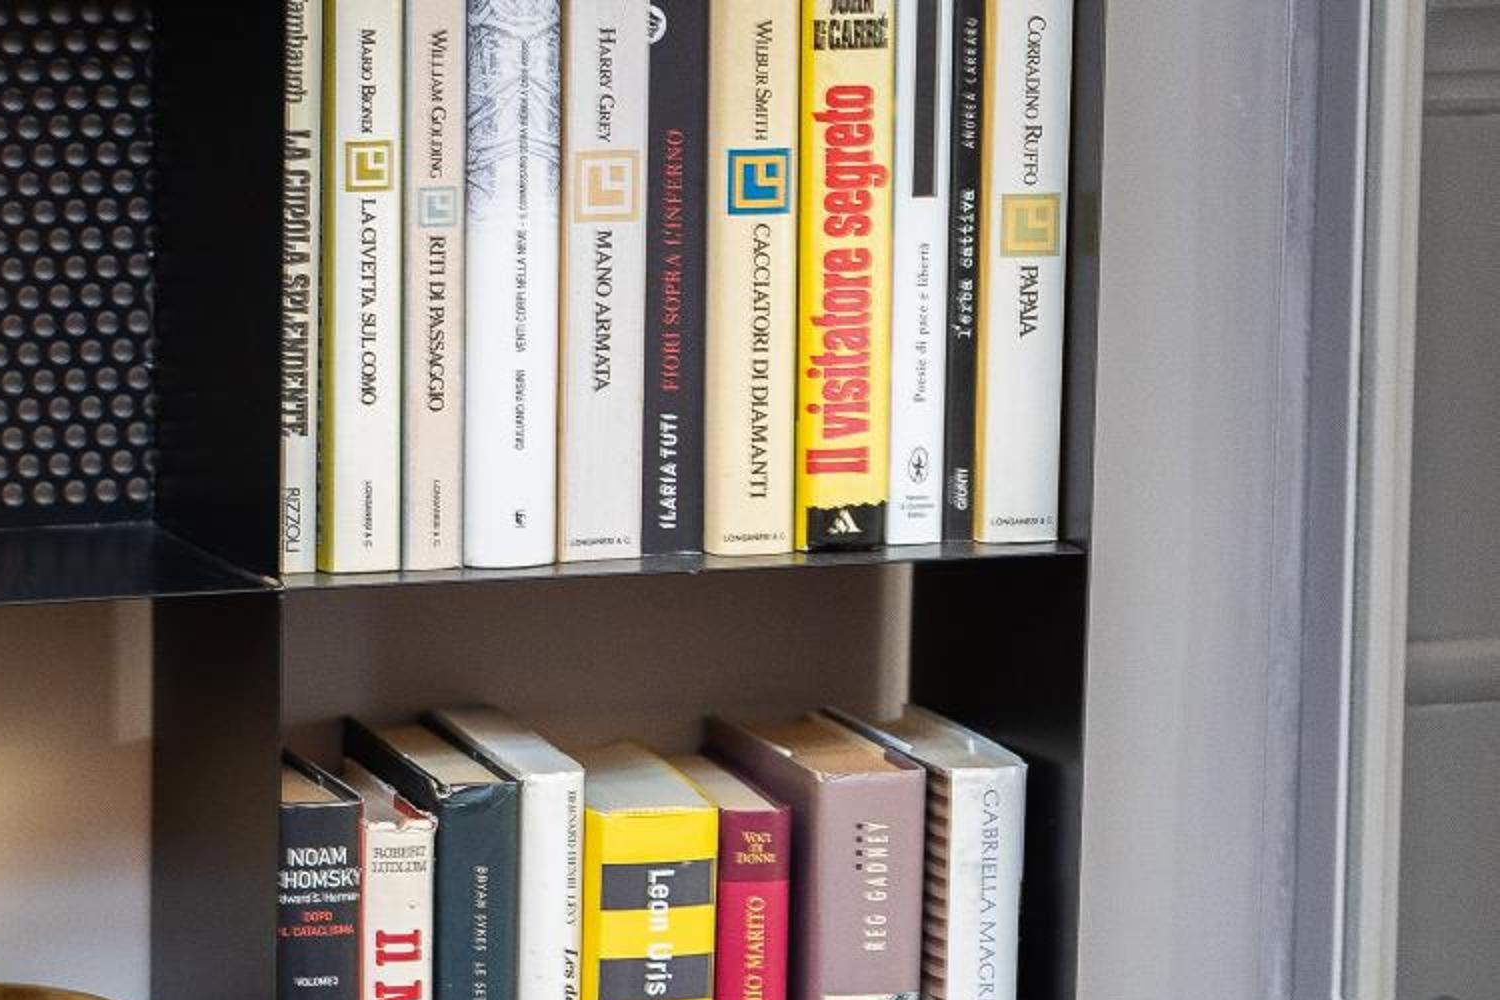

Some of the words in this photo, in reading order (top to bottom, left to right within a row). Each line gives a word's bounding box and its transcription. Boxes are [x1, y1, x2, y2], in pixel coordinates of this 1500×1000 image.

[963, 92, 977, 149] ANDREA
[663, 126, 684, 245] L'INFERNO
[811, 83, 890, 237] segreto
[283, 169, 311, 264] CUPOLA
[359, 228, 377, 307] CIVETTA
[427, 236, 445, 275] RITI
[594, 231, 612, 298] MANO
[916, 241, 930, 286] libertà
[427, 281, 445, 302] DI
[662, 253, 682, 324] SOPRA
[751, 223, 771, 352] CACCIATORI
[1018, 265, 1038, 337] PAPAIA
[359, 312, 376, 348] SUL
[593, 302, 611, 391] ARMATA
[806, 248, 872, 439] visitatore
[914, 340, 928, 353] di
[916, 304, 930, 334] pace
[281, 273, 310, 437] SPLENDENTE
[426, 306, 445, 413] PASSAGGIO
[661, 332, 680, 391] FIORI
[750, 359, 768, 379] DI
[912, 357, 927, 402] Poesie
[660, 412, 678, 457] TUTI
[747, 386, 768, 499] DIAMANTI
[805, 445, 869, 474] Il
[283, 487, 300, 553] RIZZOLI
[659, 461, 677, 528] ILARIA
[286, 847, 348, 867] NOAM
[372, 845, 426, 859] ROBERT
[866, 821, 891, 903] GADNEY
[980, 788, 1000, 912] GABRIELLA
[474, 864, 488, 909] BRYAN
[645, 868, 676, 932] Leon
[375, 929, 422, 966] Il
[473, 913, 487, 952] SYKES
[745, 895, 766, 968] MARITO
[864, 914, 888, 952] REG
[473, 961, 486, 976] LE
[562, 948, 577, 979] Les
[643, 941, 672, 996] Uris
